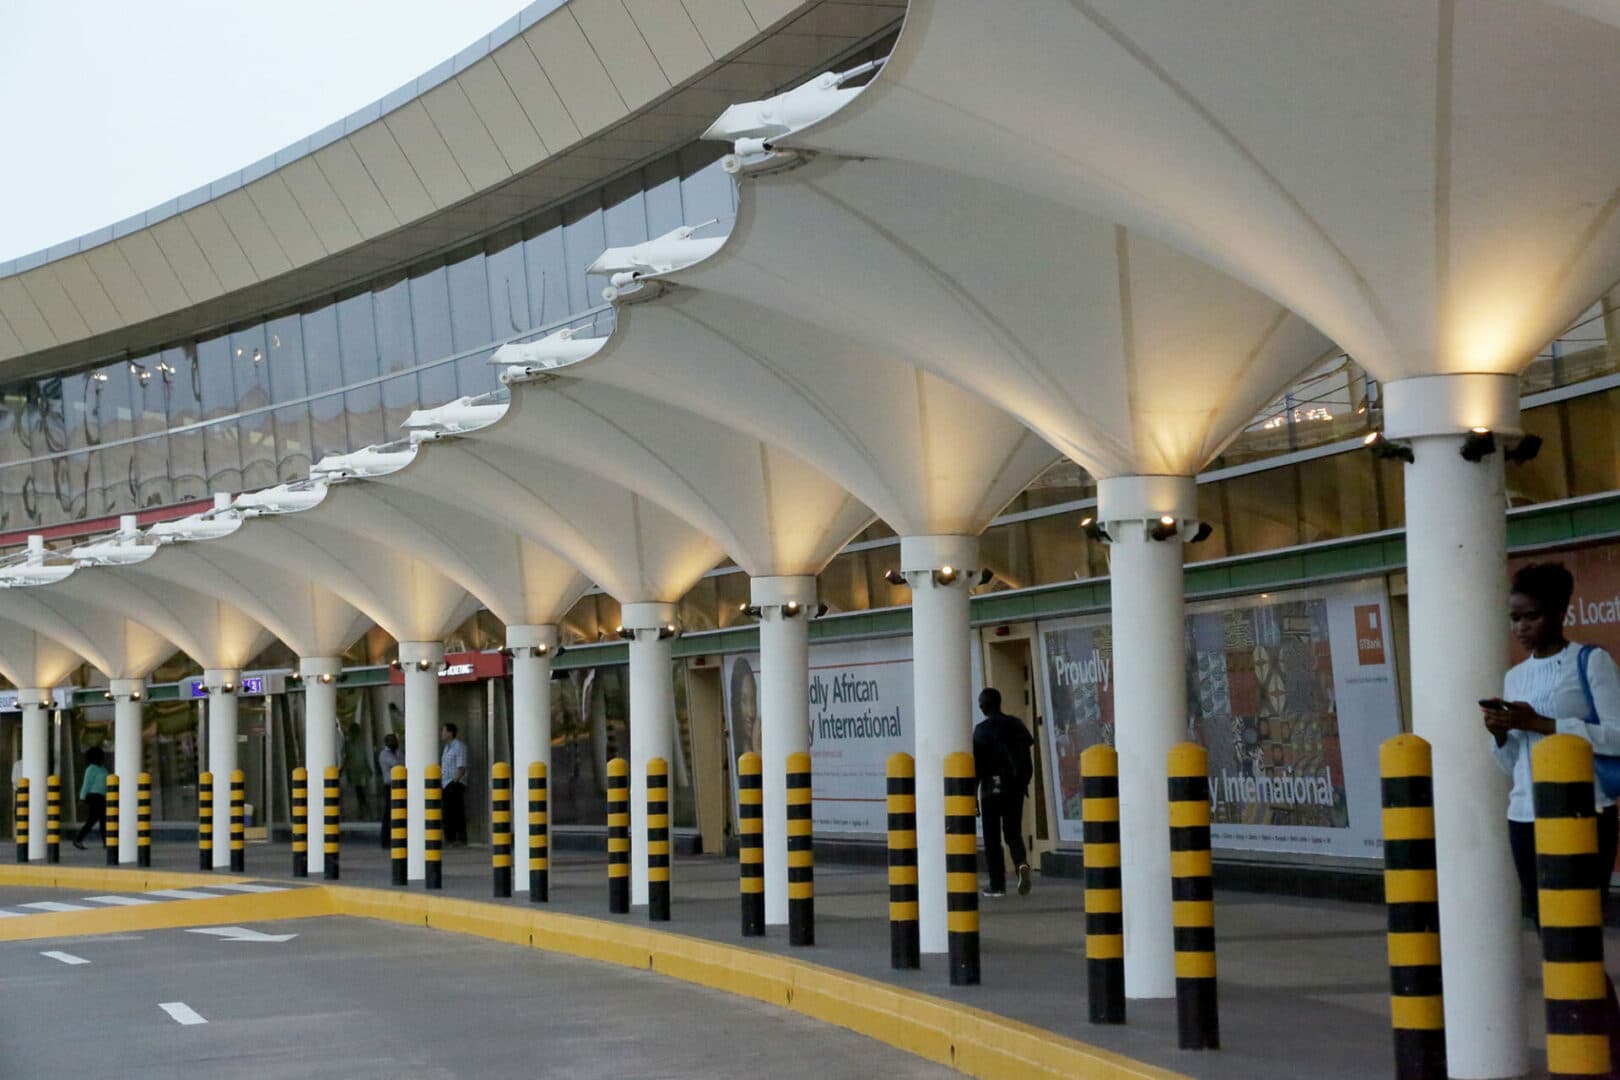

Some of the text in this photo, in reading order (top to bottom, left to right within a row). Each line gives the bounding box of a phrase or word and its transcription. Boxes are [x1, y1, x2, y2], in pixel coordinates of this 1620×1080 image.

[1055, 648, 1110, 692] Proudly
[808, 672, 879, 713] dly African
[818, 705, 902, 740] International
[1222, 765, 1334, 806] International
